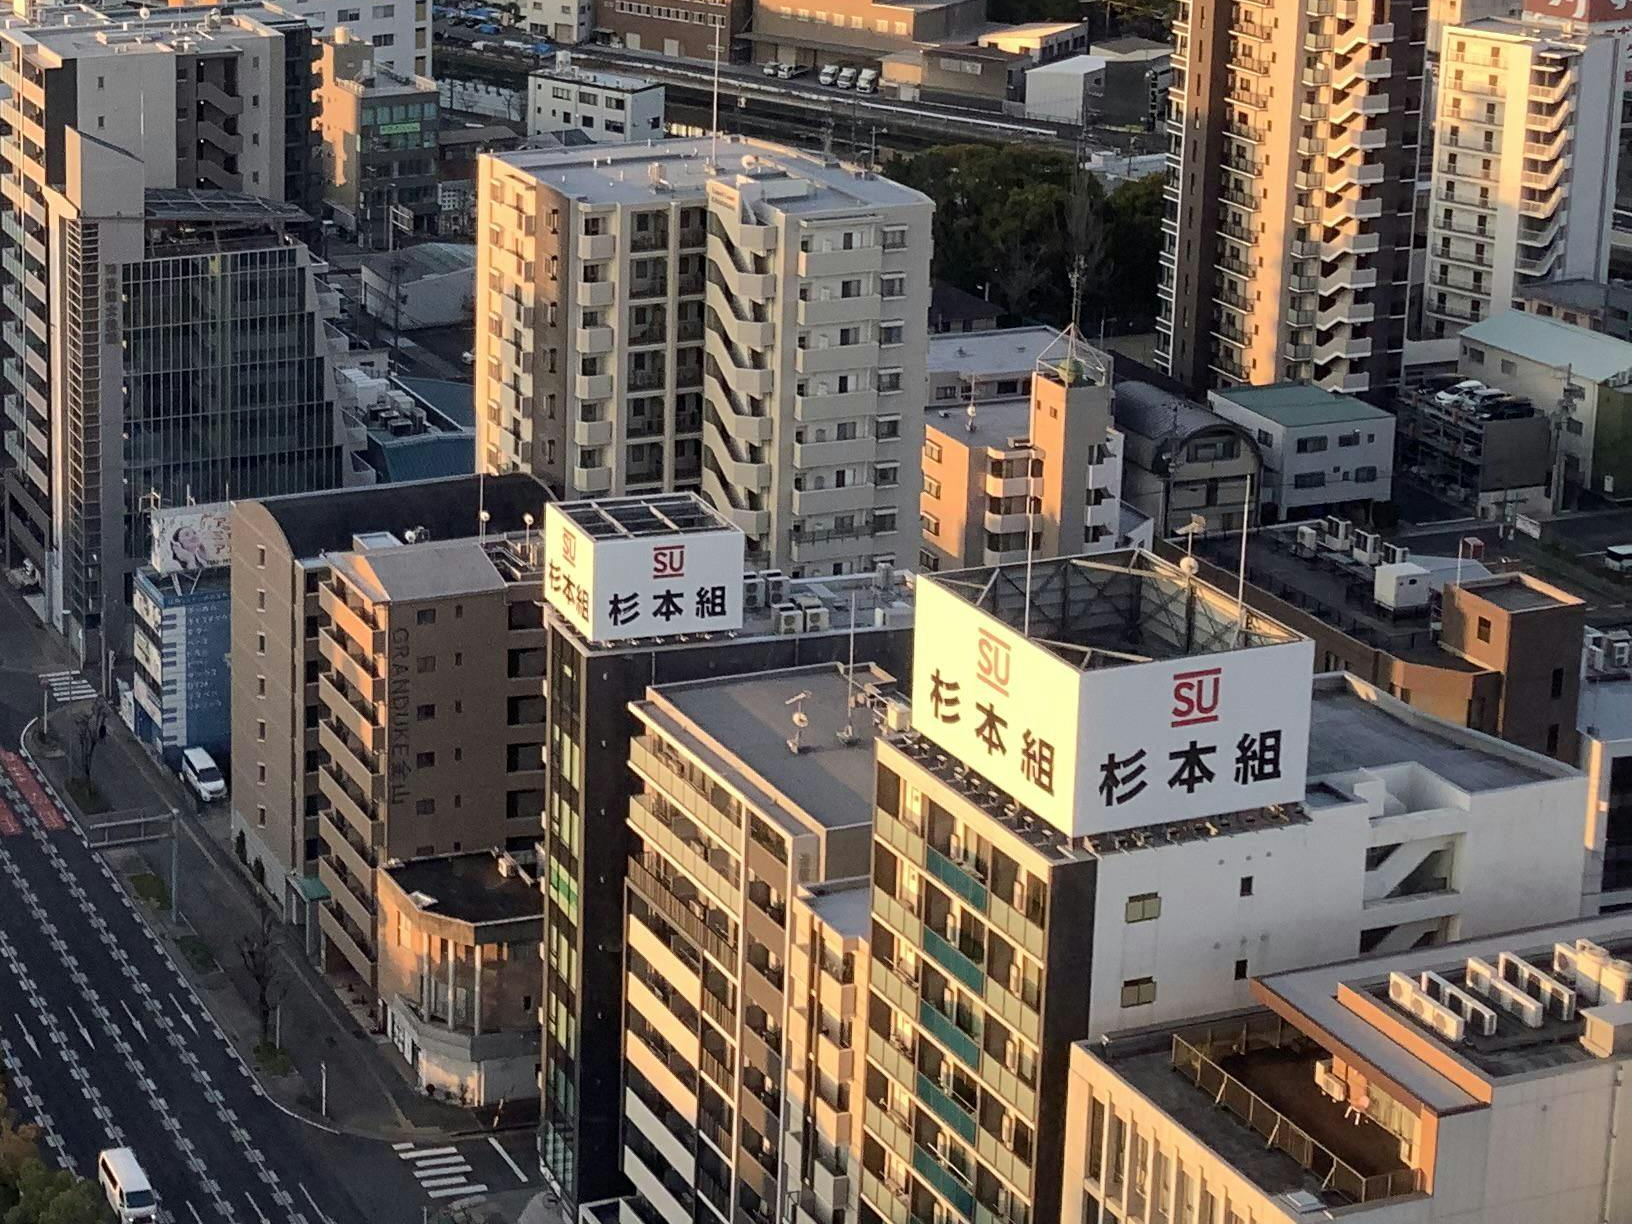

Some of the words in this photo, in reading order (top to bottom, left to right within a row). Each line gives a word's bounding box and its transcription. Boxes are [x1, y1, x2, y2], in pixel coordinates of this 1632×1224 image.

[653, 550, 684, 574] SU
[609, 586, 727, 626] 杉本組
[977, 638, 1010, 687] SU
[1171, 676, 1220, 719] SU
[930, 668, 1055, 797] 杉本組
[1099, 729, 1282, 807] 杉本組
